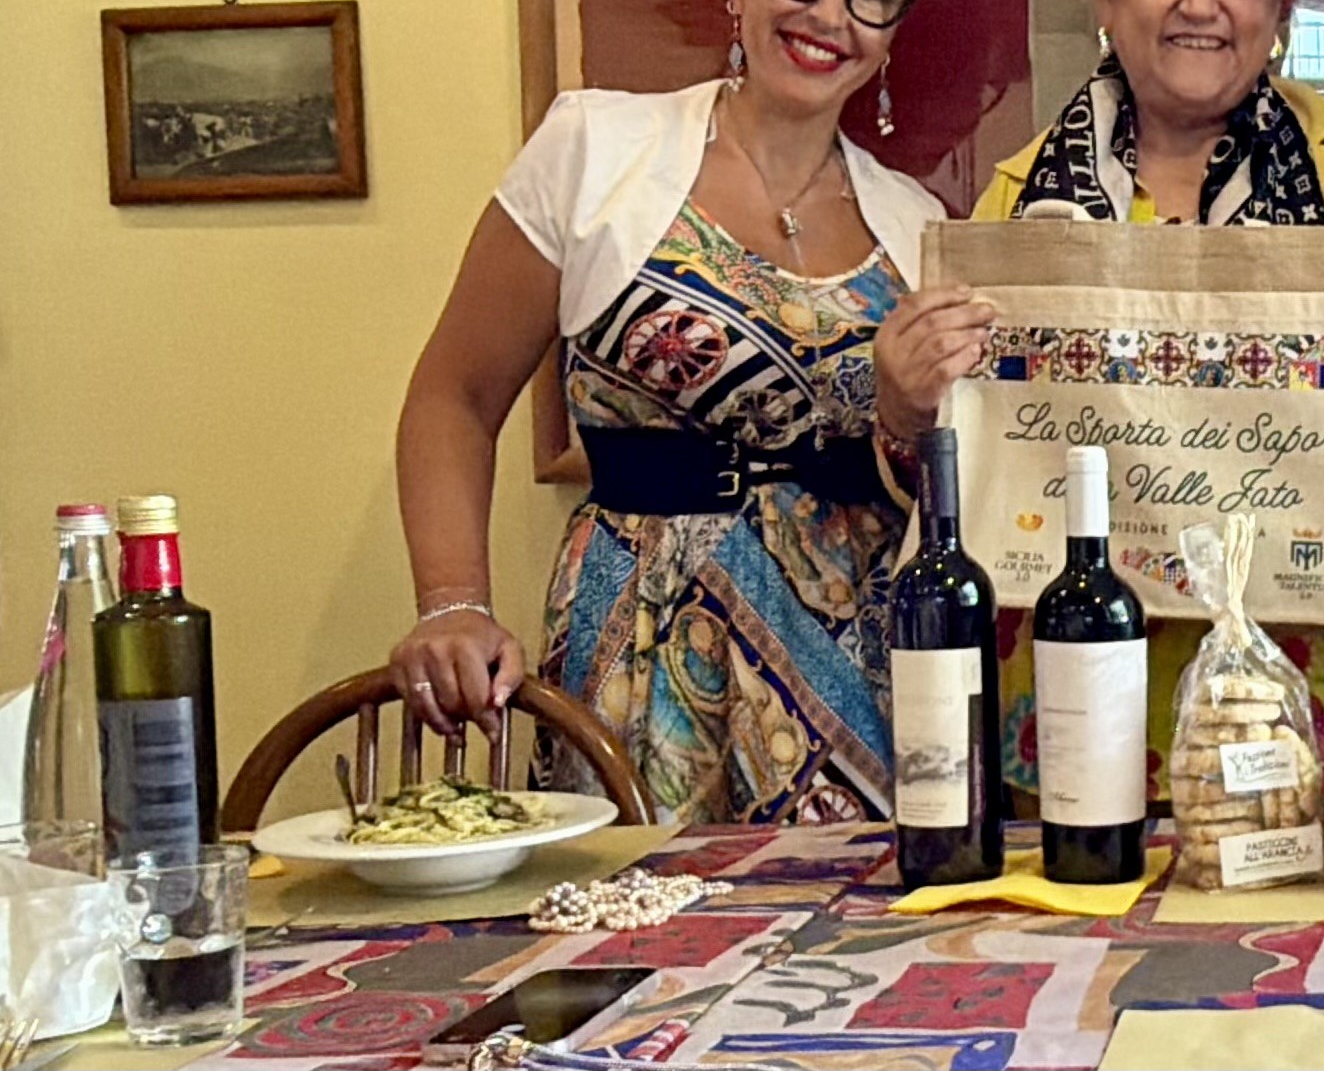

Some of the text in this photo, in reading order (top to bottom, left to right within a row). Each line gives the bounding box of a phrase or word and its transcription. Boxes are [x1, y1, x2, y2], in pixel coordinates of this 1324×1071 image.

[1005, 402, 1062, 442] La
[1066, 405, 1171, 449] Sporta
[1180, 417, 1231, 450] dei
[1125, 463, 1216, 507] Valle
[1217, 468, 1304, 513] Jato
[1109, 520, 1169, 536] DIZIONE
[995, 560, 1053, 575] GOURMET
